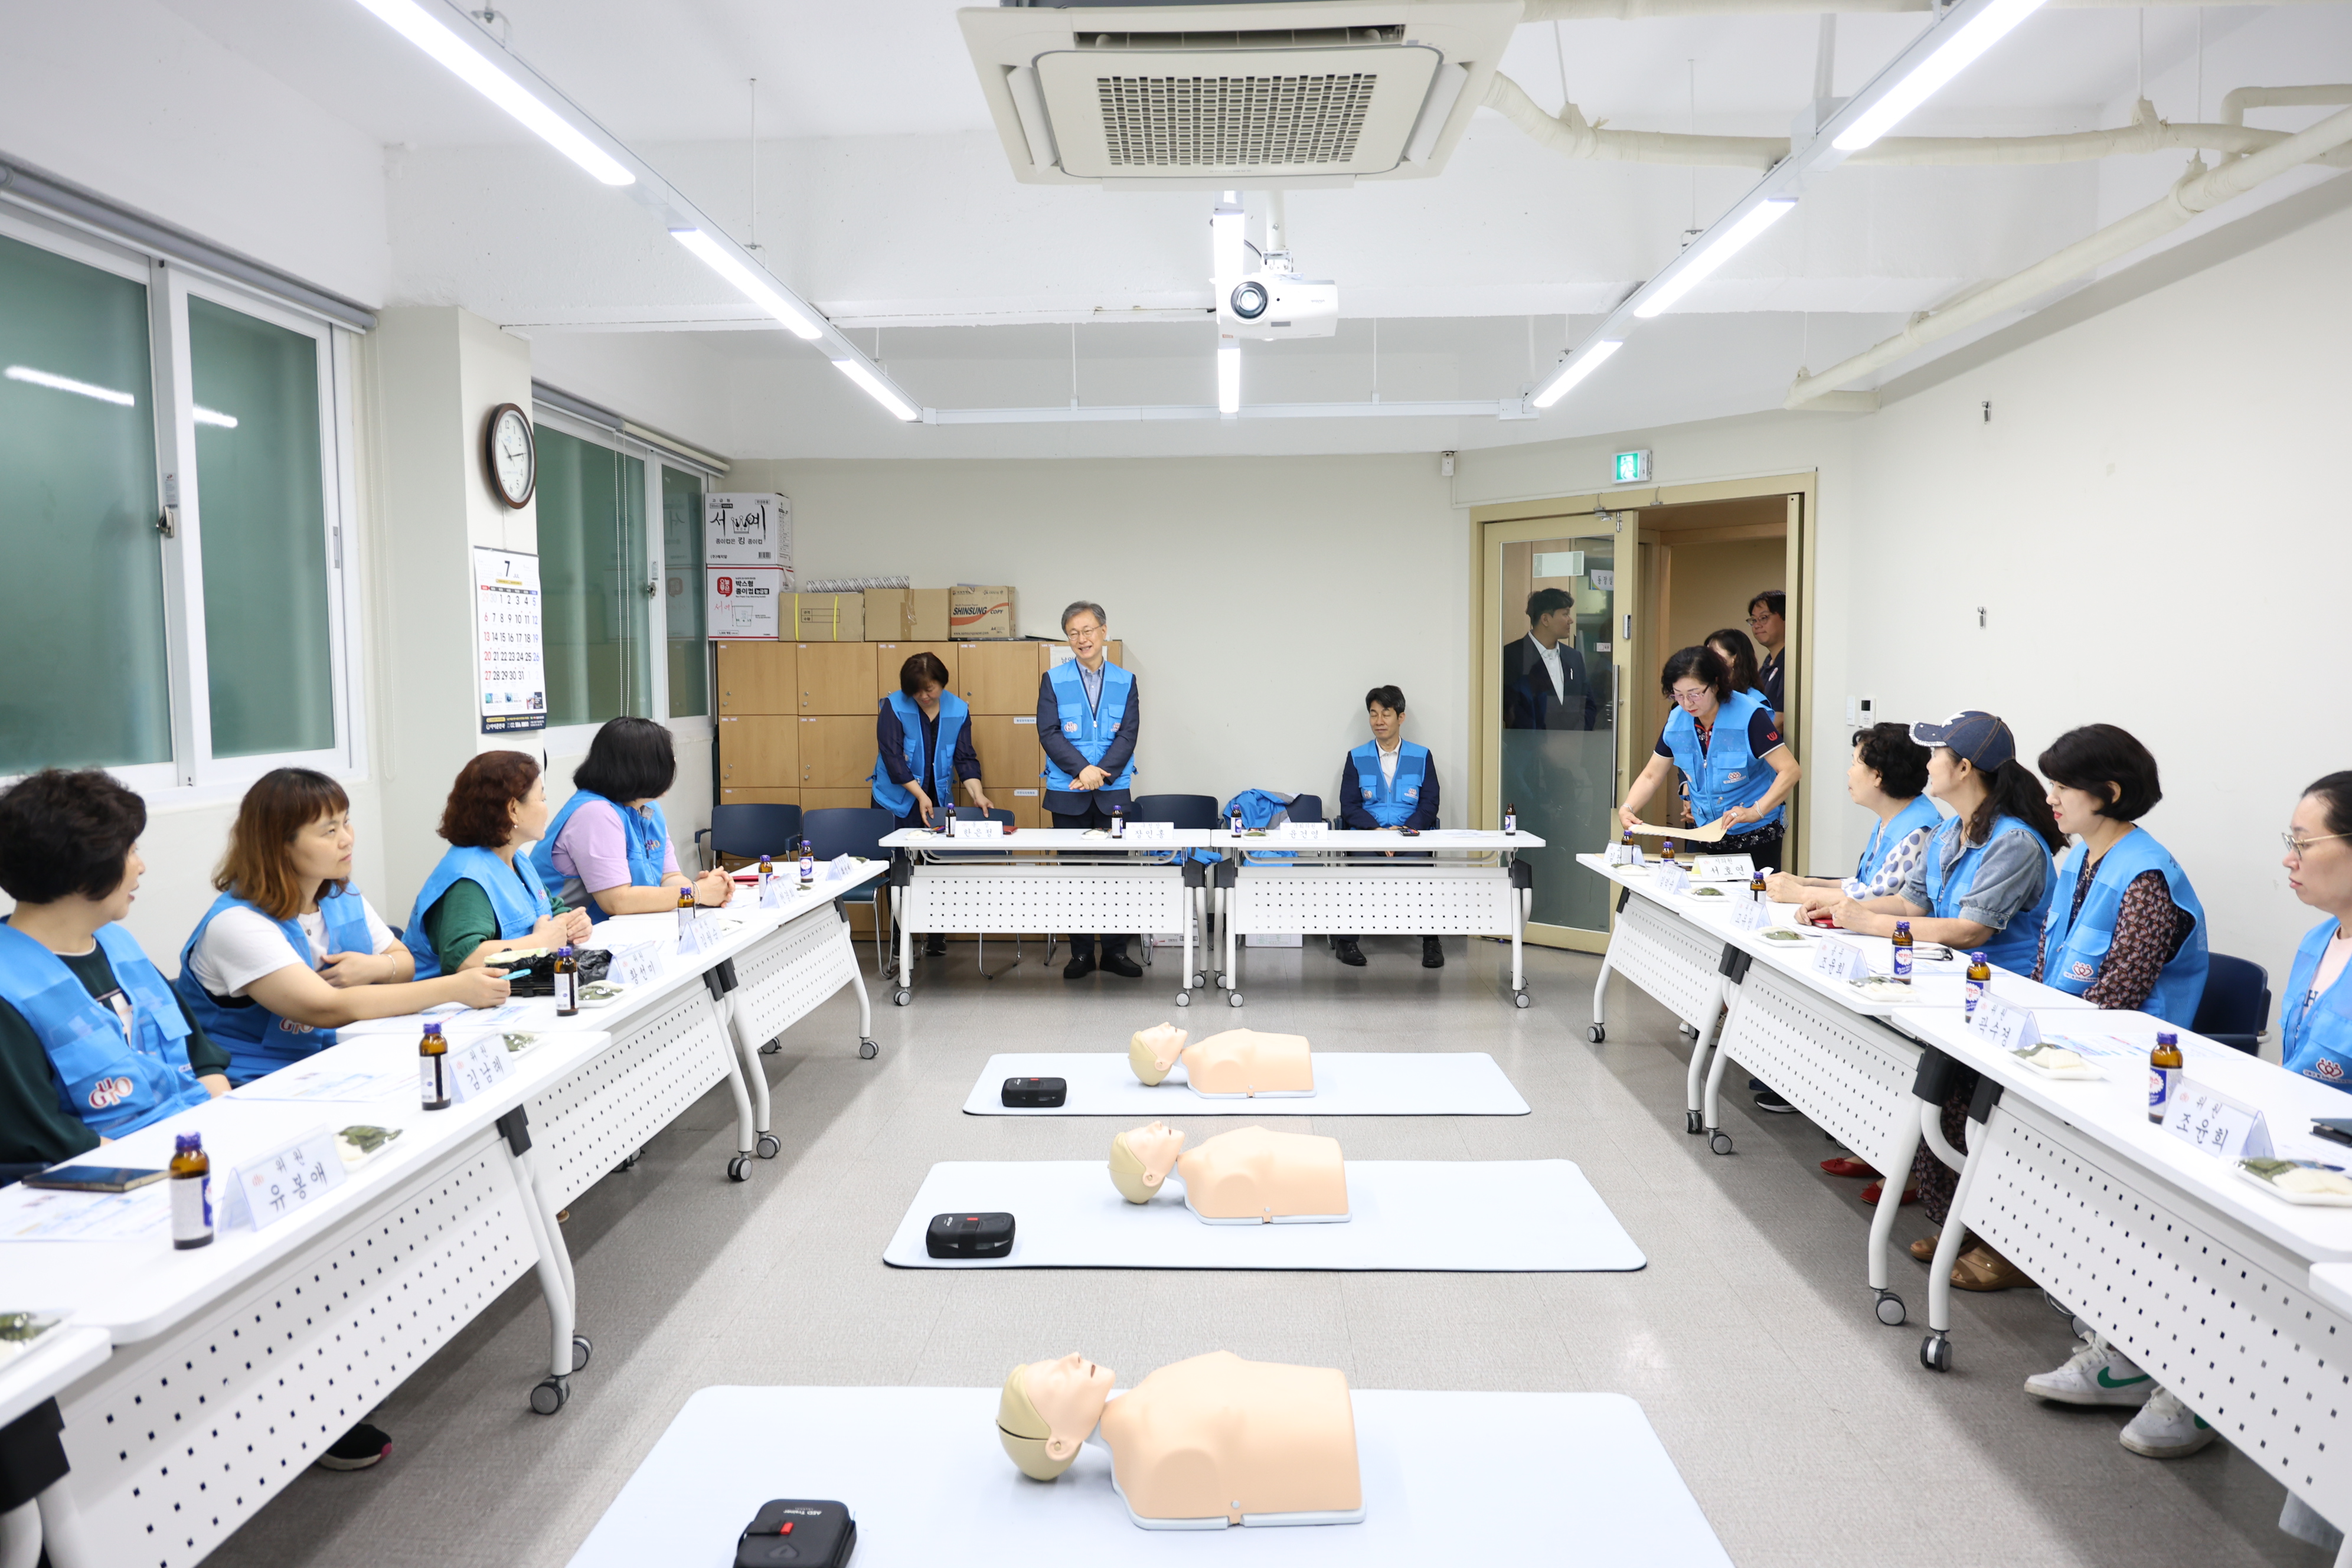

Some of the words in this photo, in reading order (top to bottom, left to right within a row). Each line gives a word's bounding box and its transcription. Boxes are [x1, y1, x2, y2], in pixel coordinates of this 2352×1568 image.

[505, 420, 509, 429] 12
[504, 560, 510, 577] 7
[500, 594, 502, 603] 1
[507, 595, 511, 604] 2
[516, 596, 520, 605] 3
[524, 597, 528, 605] 4
[533, 597, 536, 606] 5
[953, 607, 987, 615] SHINSUNG
[484, 612, 488, 622] 6
[492, 613, 496, 622] 7
[500, 613, 504, 622] 8
[508, 614, 511, 623] 9
[515, 615, 521, 623] 10
[525, 615, 530, 624] 11
[533, 616, 538, 625] 12
[484, 632, 490, 641] 13
[492, 632, 498, 641] 14
[500, 632, 505, 642] 15
[508, 633, 514, 642] 16
[516, 633, 522, 642] 17
[525, 633, 530, 642] 18
[533, 634, 538, 643] 19
[484, 651, 491, 661] 20
[494, 652, 499, 661] 21
[501, 652, 507, 661] 22
[509, 652, 515, 661] 23
[517, 652, 523, 661] 24
[525, 652, 532, 661] 25
[533, 652, 540, 661] 26
[485, 671, 491, 680] 27
[493, 671, 500, 680] 28
[501, 671, 508, 680] 29
[509, 671, 516, 680] 30
[518, 671, 524, 680] 31
[1135, 829, 1164, 838] 장인홍
[1289, 829, 1318, 839] 윤건영
[1711, 865, 1744, 876] 서호연
[632, 950, 645, 963] 위원
[629, 961, 656, 985] 황선미
[1991, 1004, 2007, 1021] 위원
[469, 1043, 488, 1062] 위원
[466, 1056, 504, 1091] 김남례
[2196, 1096, 2223, 1119] 위원
[2176, 1113, 2229, 1154] 조윤희
[276, 1148, 305, 1174] 위원
[269, 1162, 328, 1212] 유봉애
